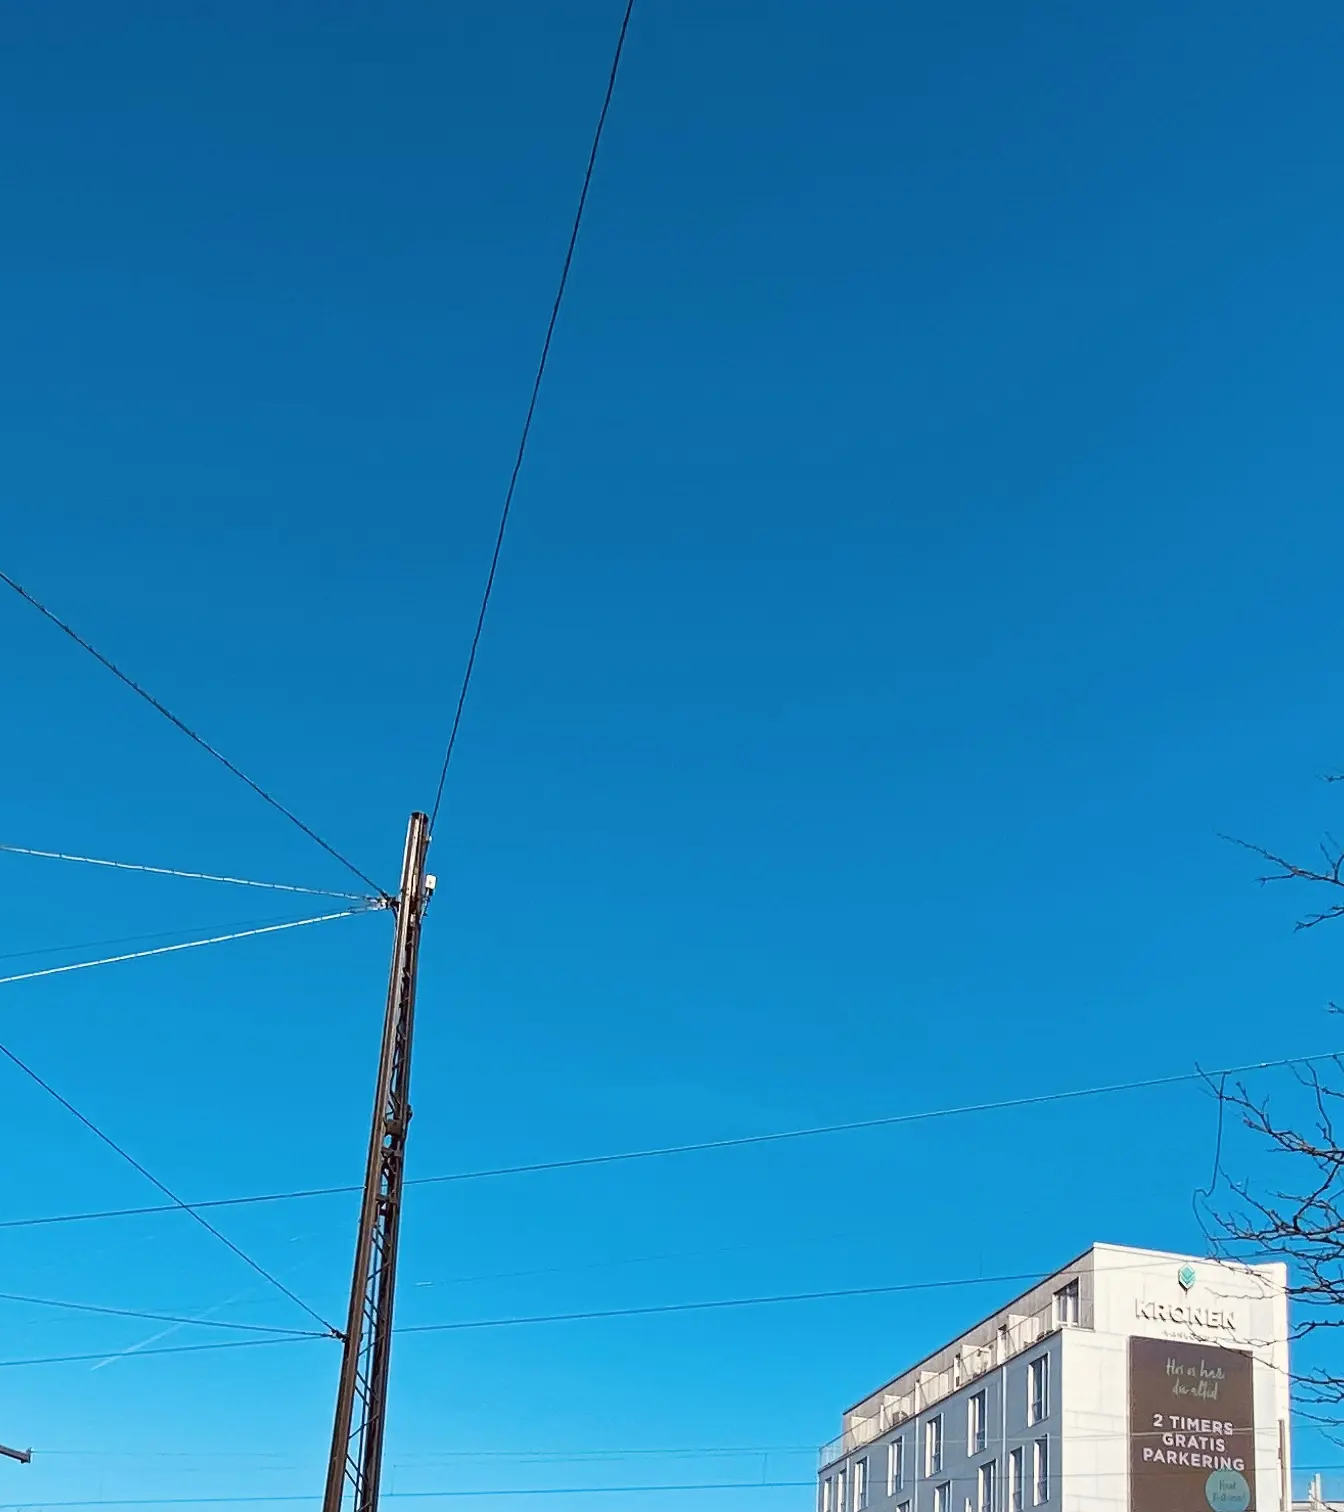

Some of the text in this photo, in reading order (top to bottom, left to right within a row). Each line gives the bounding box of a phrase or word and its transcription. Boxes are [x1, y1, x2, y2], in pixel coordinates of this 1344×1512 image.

[1135, 1298, 1236, 1331] KRONEN
[1153, 1414, 1233, 1435] 2 TIMERS
[1162, 1434, 1225, 1452] GRATIS
[1143, 1448, 1244, 1471] PARKERING
